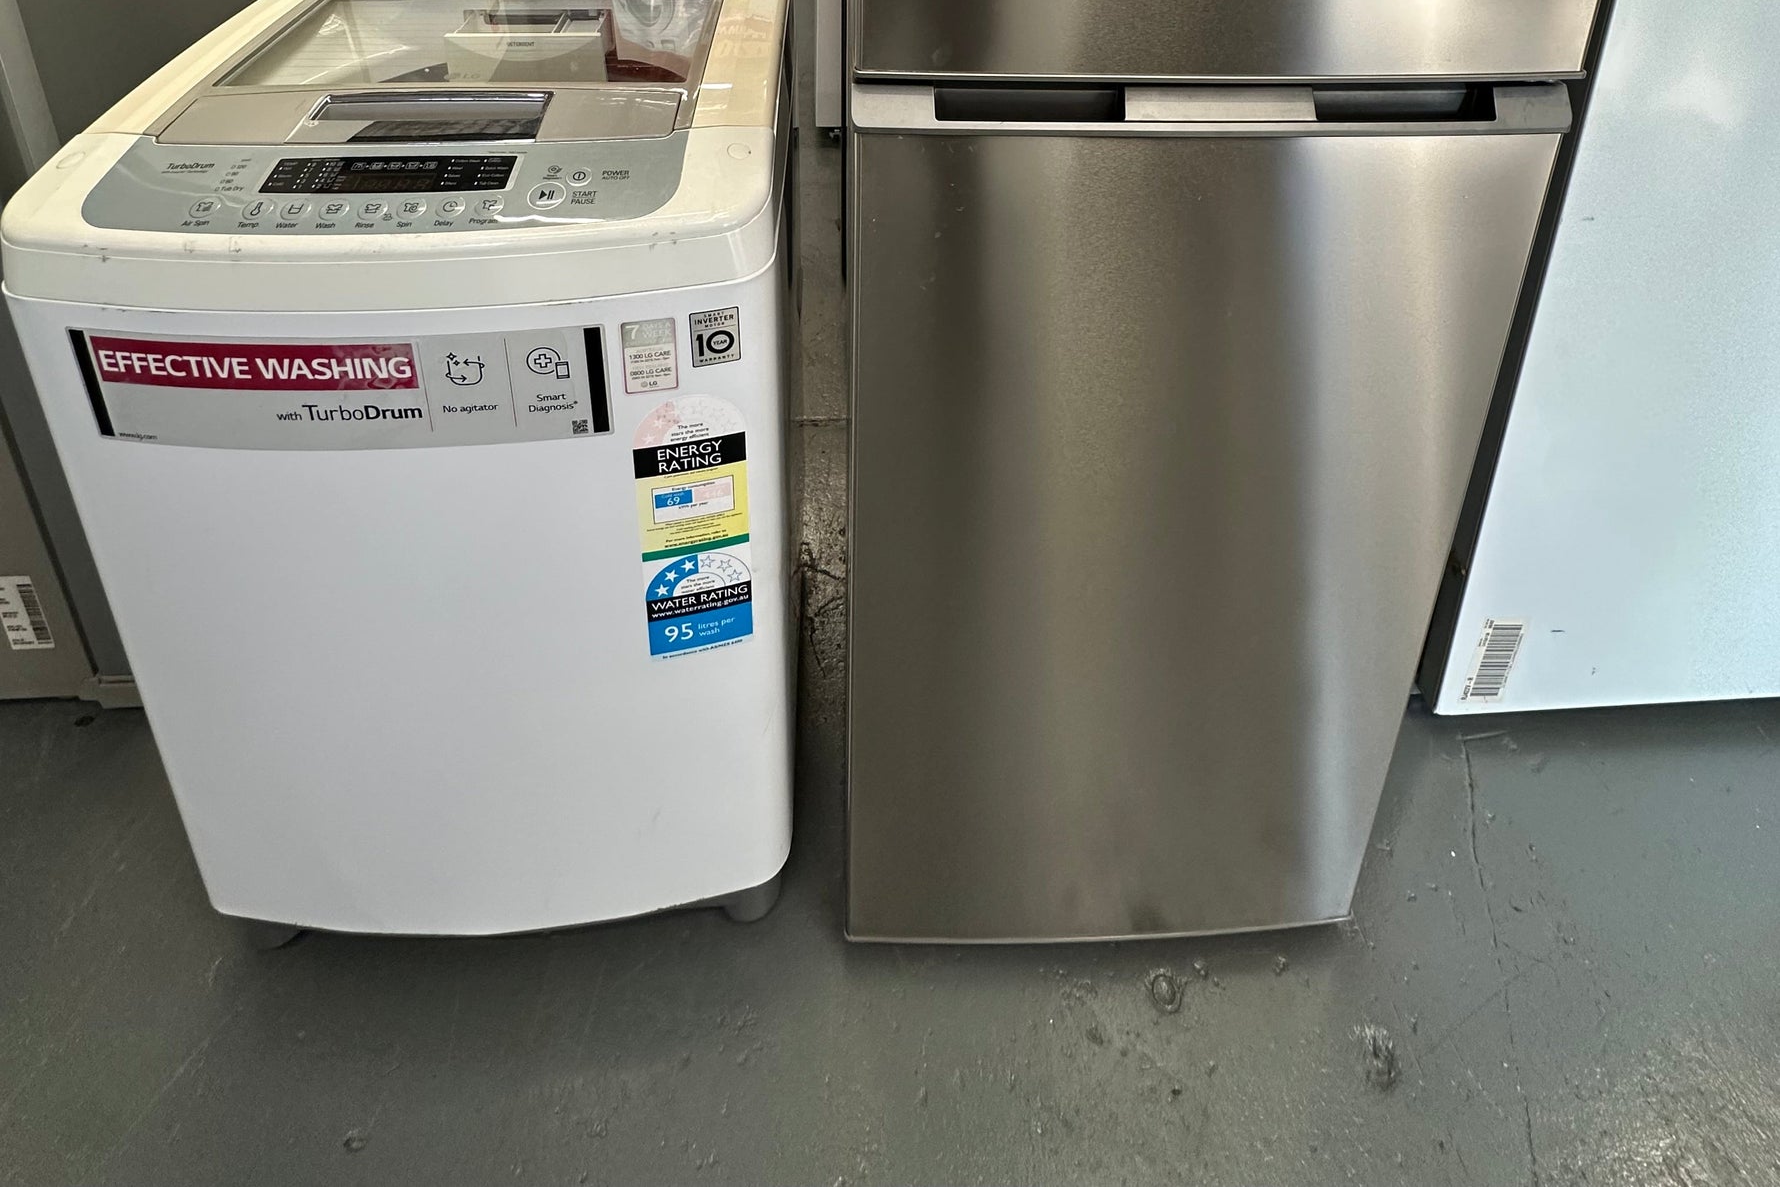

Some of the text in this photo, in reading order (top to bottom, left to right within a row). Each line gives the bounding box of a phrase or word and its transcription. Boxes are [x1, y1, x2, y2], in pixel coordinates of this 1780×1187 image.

[166, 162, 215, 170] TurboDrum
[572, 190, 598, 198] START
[193, 219, 210, 228] Spin
[237, 221, 259, 230] Temp
[396, 221, 412, 229] Spin
[433, 219, 454, 228] Delay
[694, 314, 734, 325] INVERTER
[625, 324, 640, 340] 7
[696, 329, 735, 357] 10
[654, 350, 671, 358] CARE
[699, 354, 735, 363] WARRANTY
[97, 349, 412, 381] EFFECTIVE WASHING
[536, 393, 567, 402] Smart
[276, 404, 423, 423] with TurboDrum
[443, 404, 498, 414] No agitator
[688, 432, 710, 440] efficient
[657, 439, 722, 461] ENERGY
[658, 453, 722, 473] RATING
[666, 496, 681, 506] 69
[651, 584, 748, 611] WATER RATING
[651, 594, 749, 619] www.waterrating.gov.au
[664, 616, 736, 643] 95 litres per
[698, 627, 720, 637] wash
